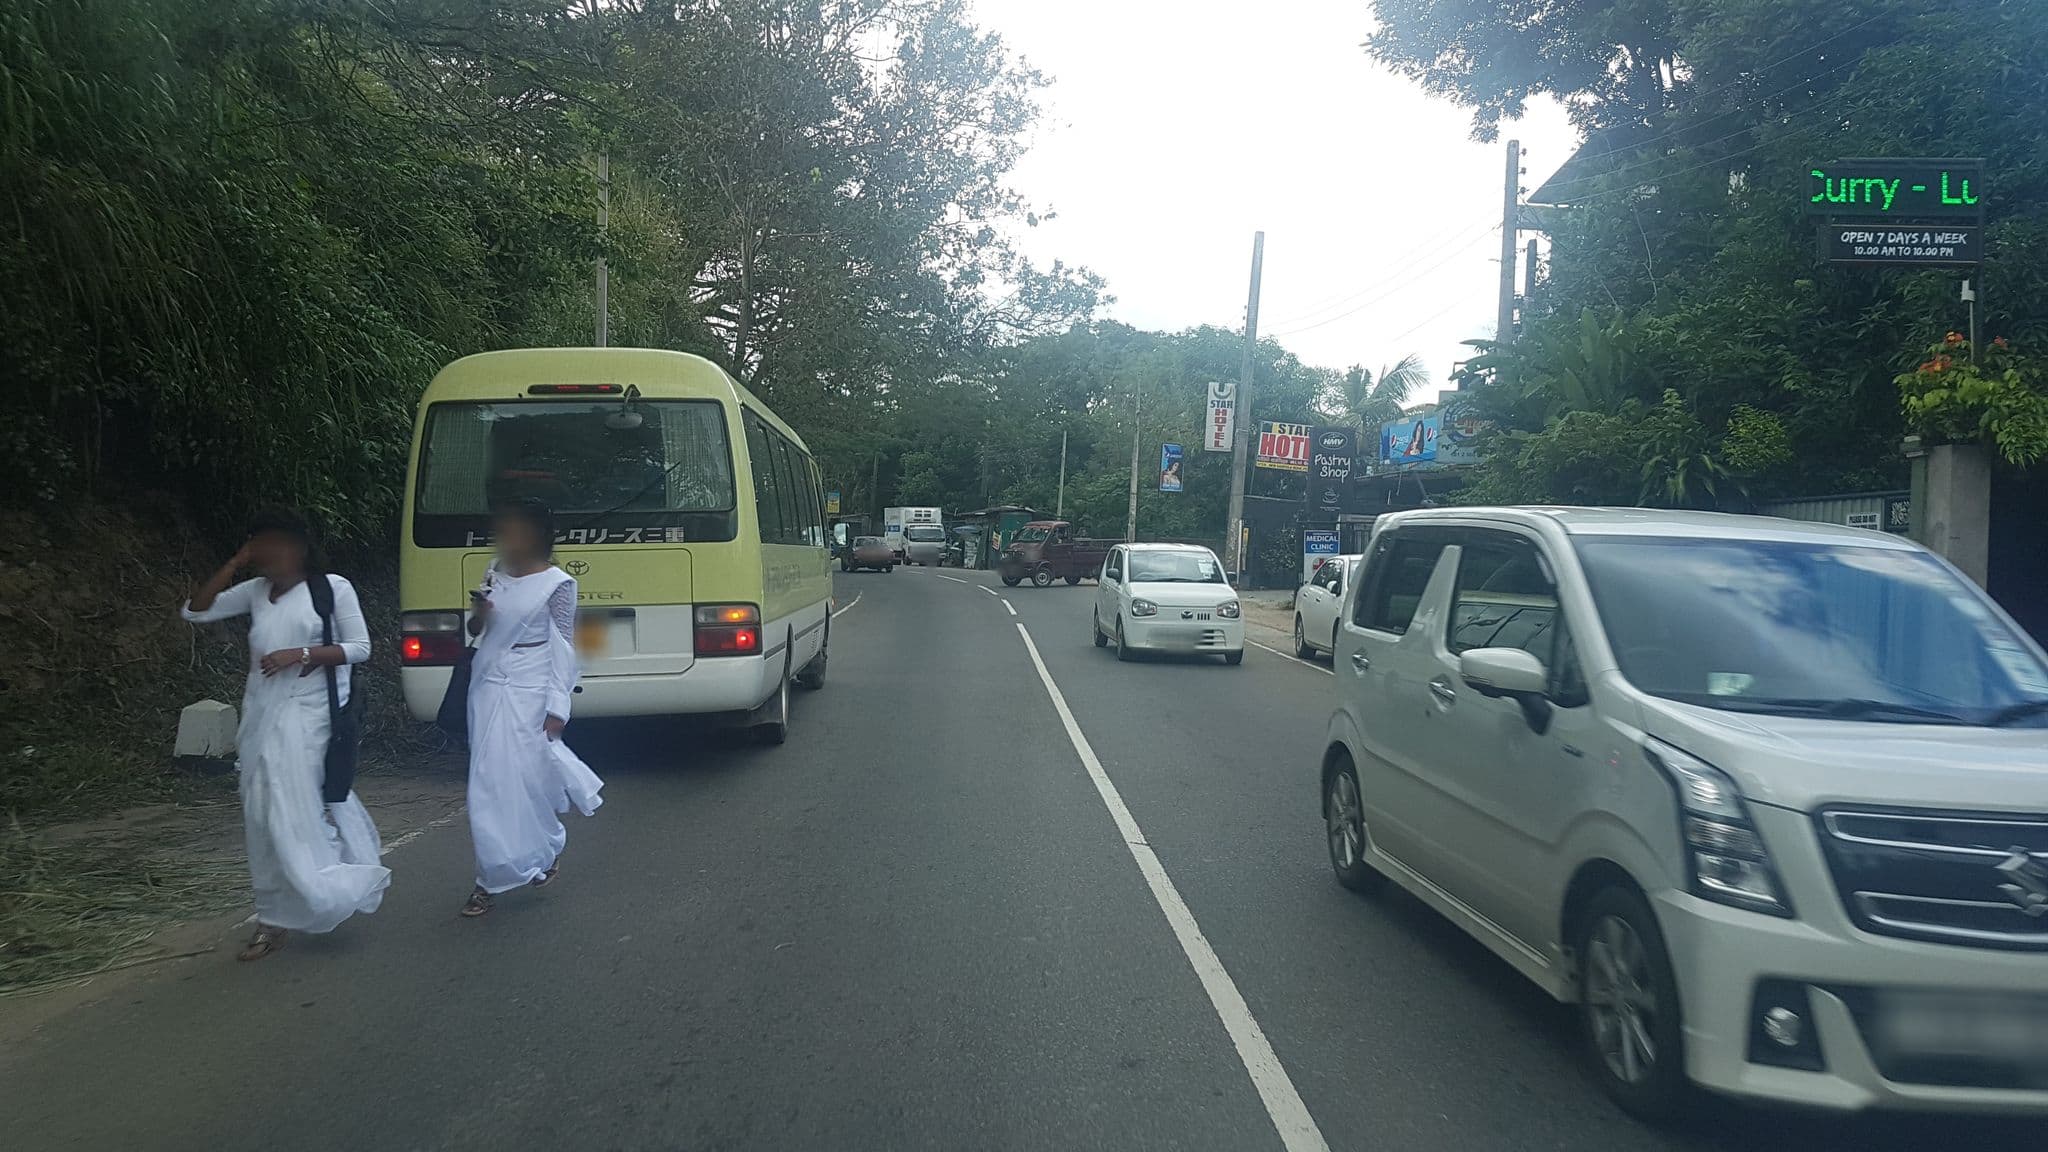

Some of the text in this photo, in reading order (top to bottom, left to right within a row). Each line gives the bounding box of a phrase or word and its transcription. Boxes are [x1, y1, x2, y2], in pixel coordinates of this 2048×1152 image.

[1811, 169, 1900, 210] Curry
[1840, 232, 1968, 244] OPEN 7 DAYS A WEEK
[1854, 246, 1953, 257] 10.00 AM TO 10.00 PM
[1213, 409, 1228, 448] HOTEL
[1314, 453, 1351, 472] Pastry
[1320, 466, 1348, 484] Shop
[576, 591, 625, 601] STER
